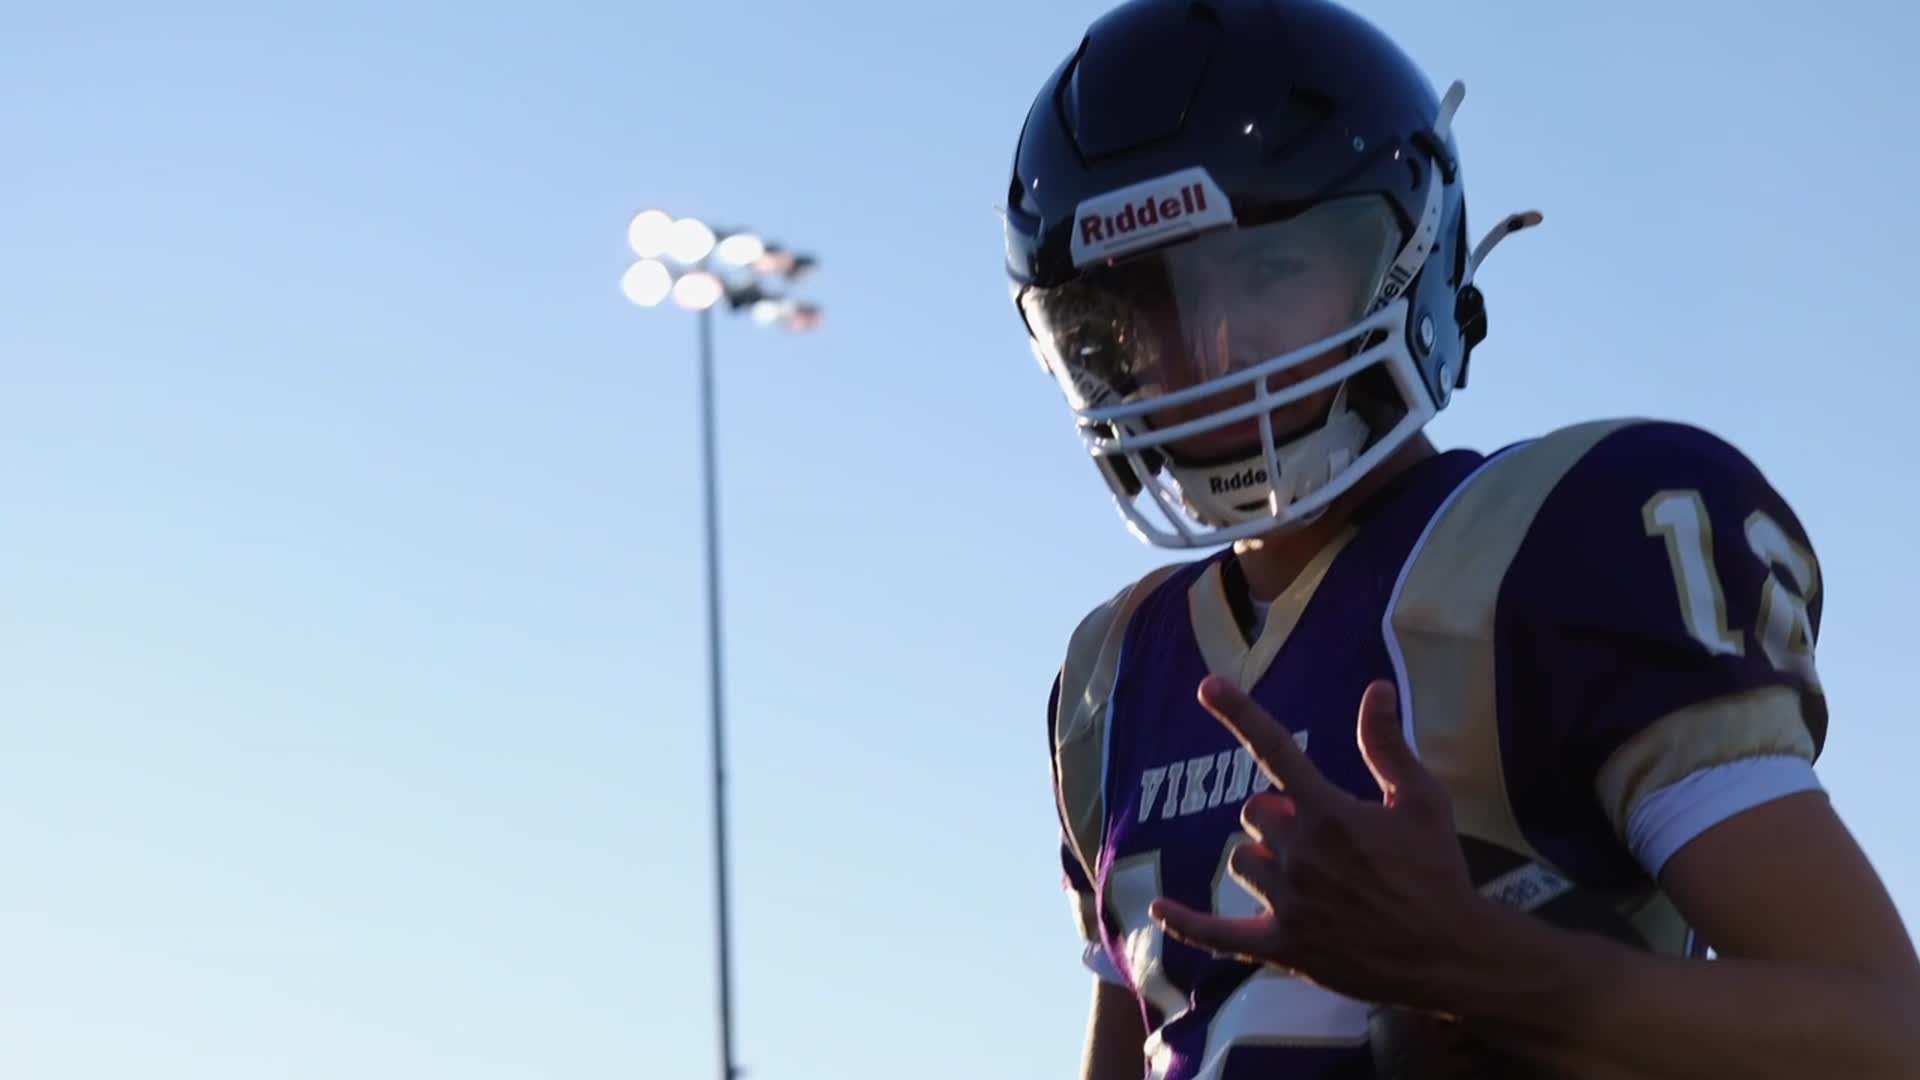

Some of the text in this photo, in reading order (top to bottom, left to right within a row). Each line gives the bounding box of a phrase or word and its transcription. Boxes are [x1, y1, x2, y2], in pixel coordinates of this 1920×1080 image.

[1080, 183, 1207, 246] Riddell
[1208, 462, 1281, 495] Ridde
[1137, 729, 1308, 823] VIKIN
